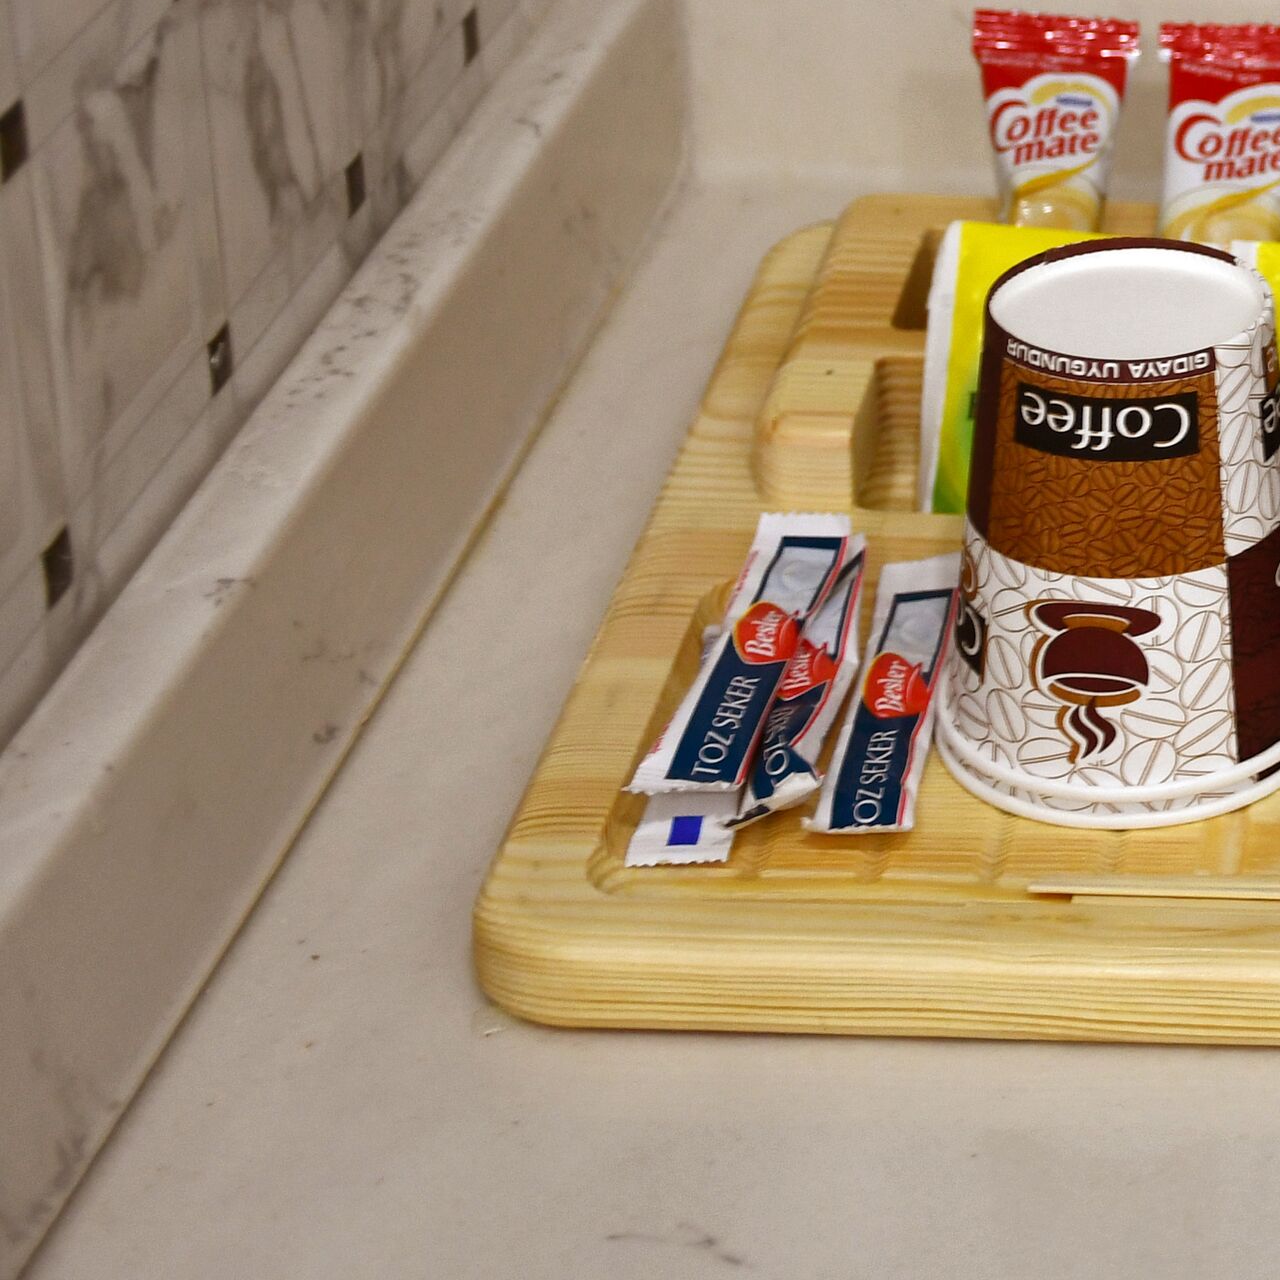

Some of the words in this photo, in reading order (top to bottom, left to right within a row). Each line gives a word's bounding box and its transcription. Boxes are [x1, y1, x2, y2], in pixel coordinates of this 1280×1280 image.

[990, 99, 1100, 153] Coffee
[1014, 131, 1100, 166] mate
[1007, 337, 1120, 379] UYGUNDUR
[1130, 350, 1211, 379] GIDAYA
[1020, 392, 1190, 451] Coffee
[876, 660, 909, 713] Besler
[691, 724, 735, 776] TOZ
